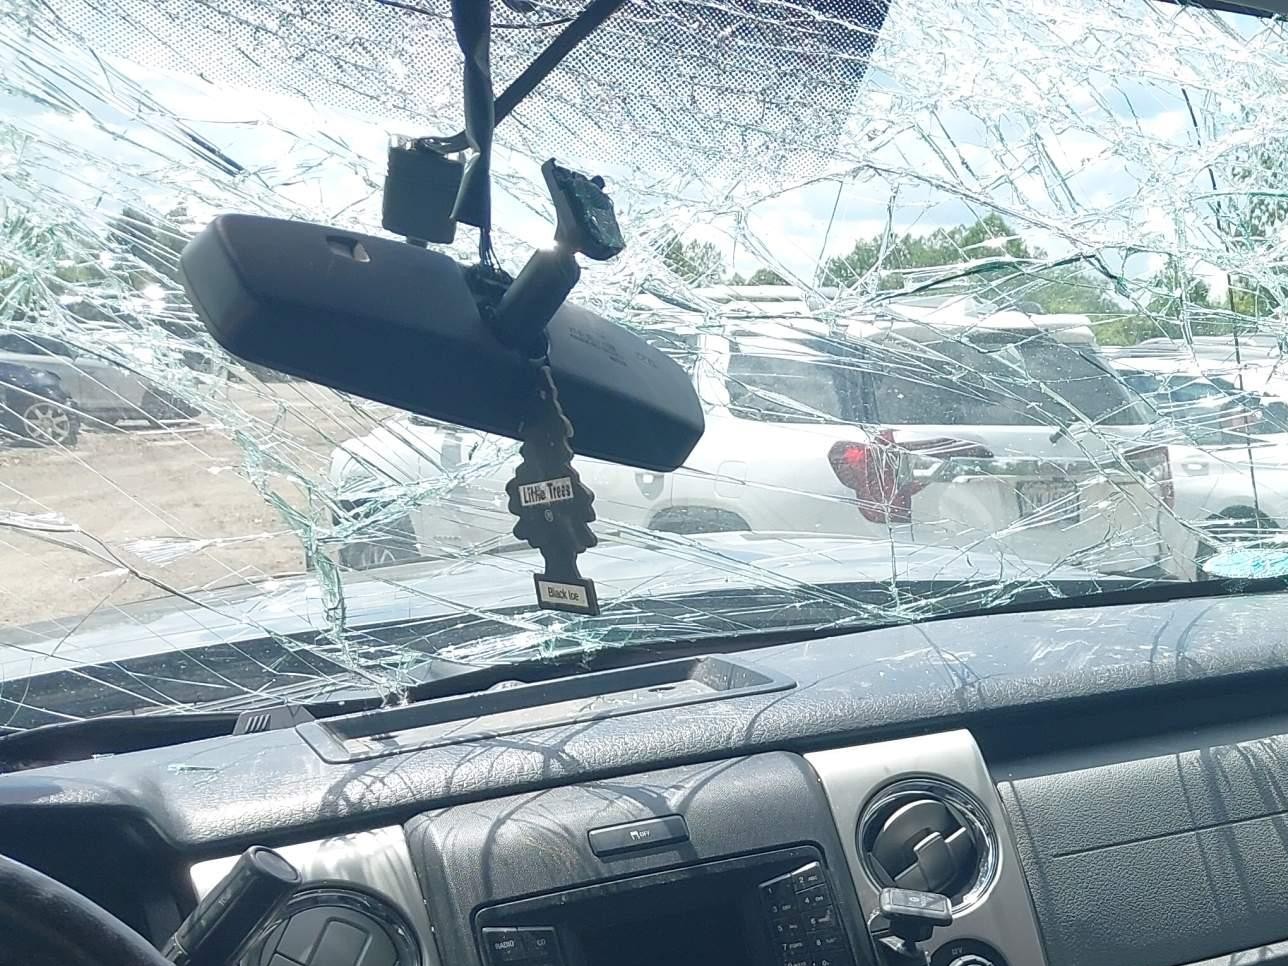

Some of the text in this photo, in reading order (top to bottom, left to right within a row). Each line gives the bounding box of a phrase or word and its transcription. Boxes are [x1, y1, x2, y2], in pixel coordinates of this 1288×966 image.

[522, 481, 571, 504] Little Trees
[547, 587, 580, 601] Black Ice
[494, 940, 515, 950] RADIO
